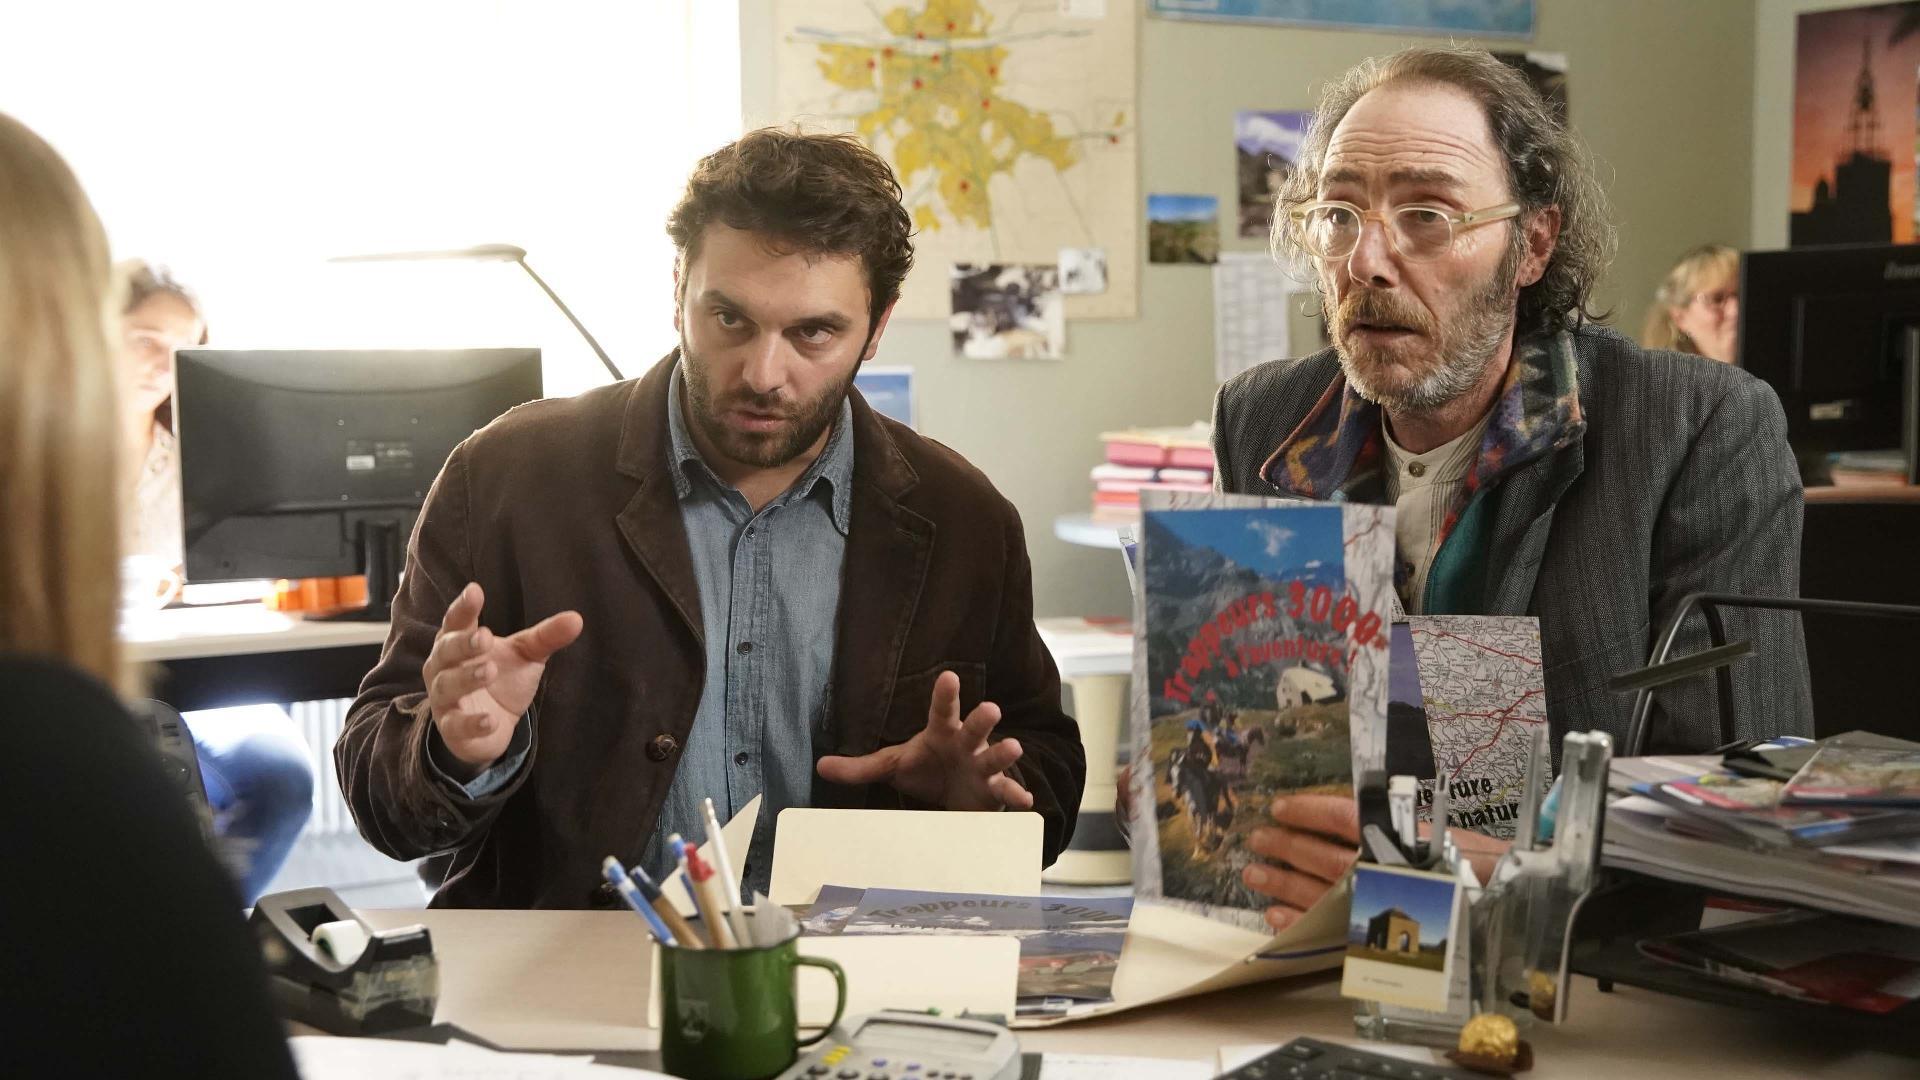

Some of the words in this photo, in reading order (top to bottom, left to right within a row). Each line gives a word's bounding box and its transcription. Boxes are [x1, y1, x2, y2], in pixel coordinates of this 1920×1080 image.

[1164, 591, 1276, 703] Trappeurs
[1458, 802, 1520, 828] natur
[868, 899, 1031, 918] Trappeurs
[1042, 903, 1124, 921] 3000
